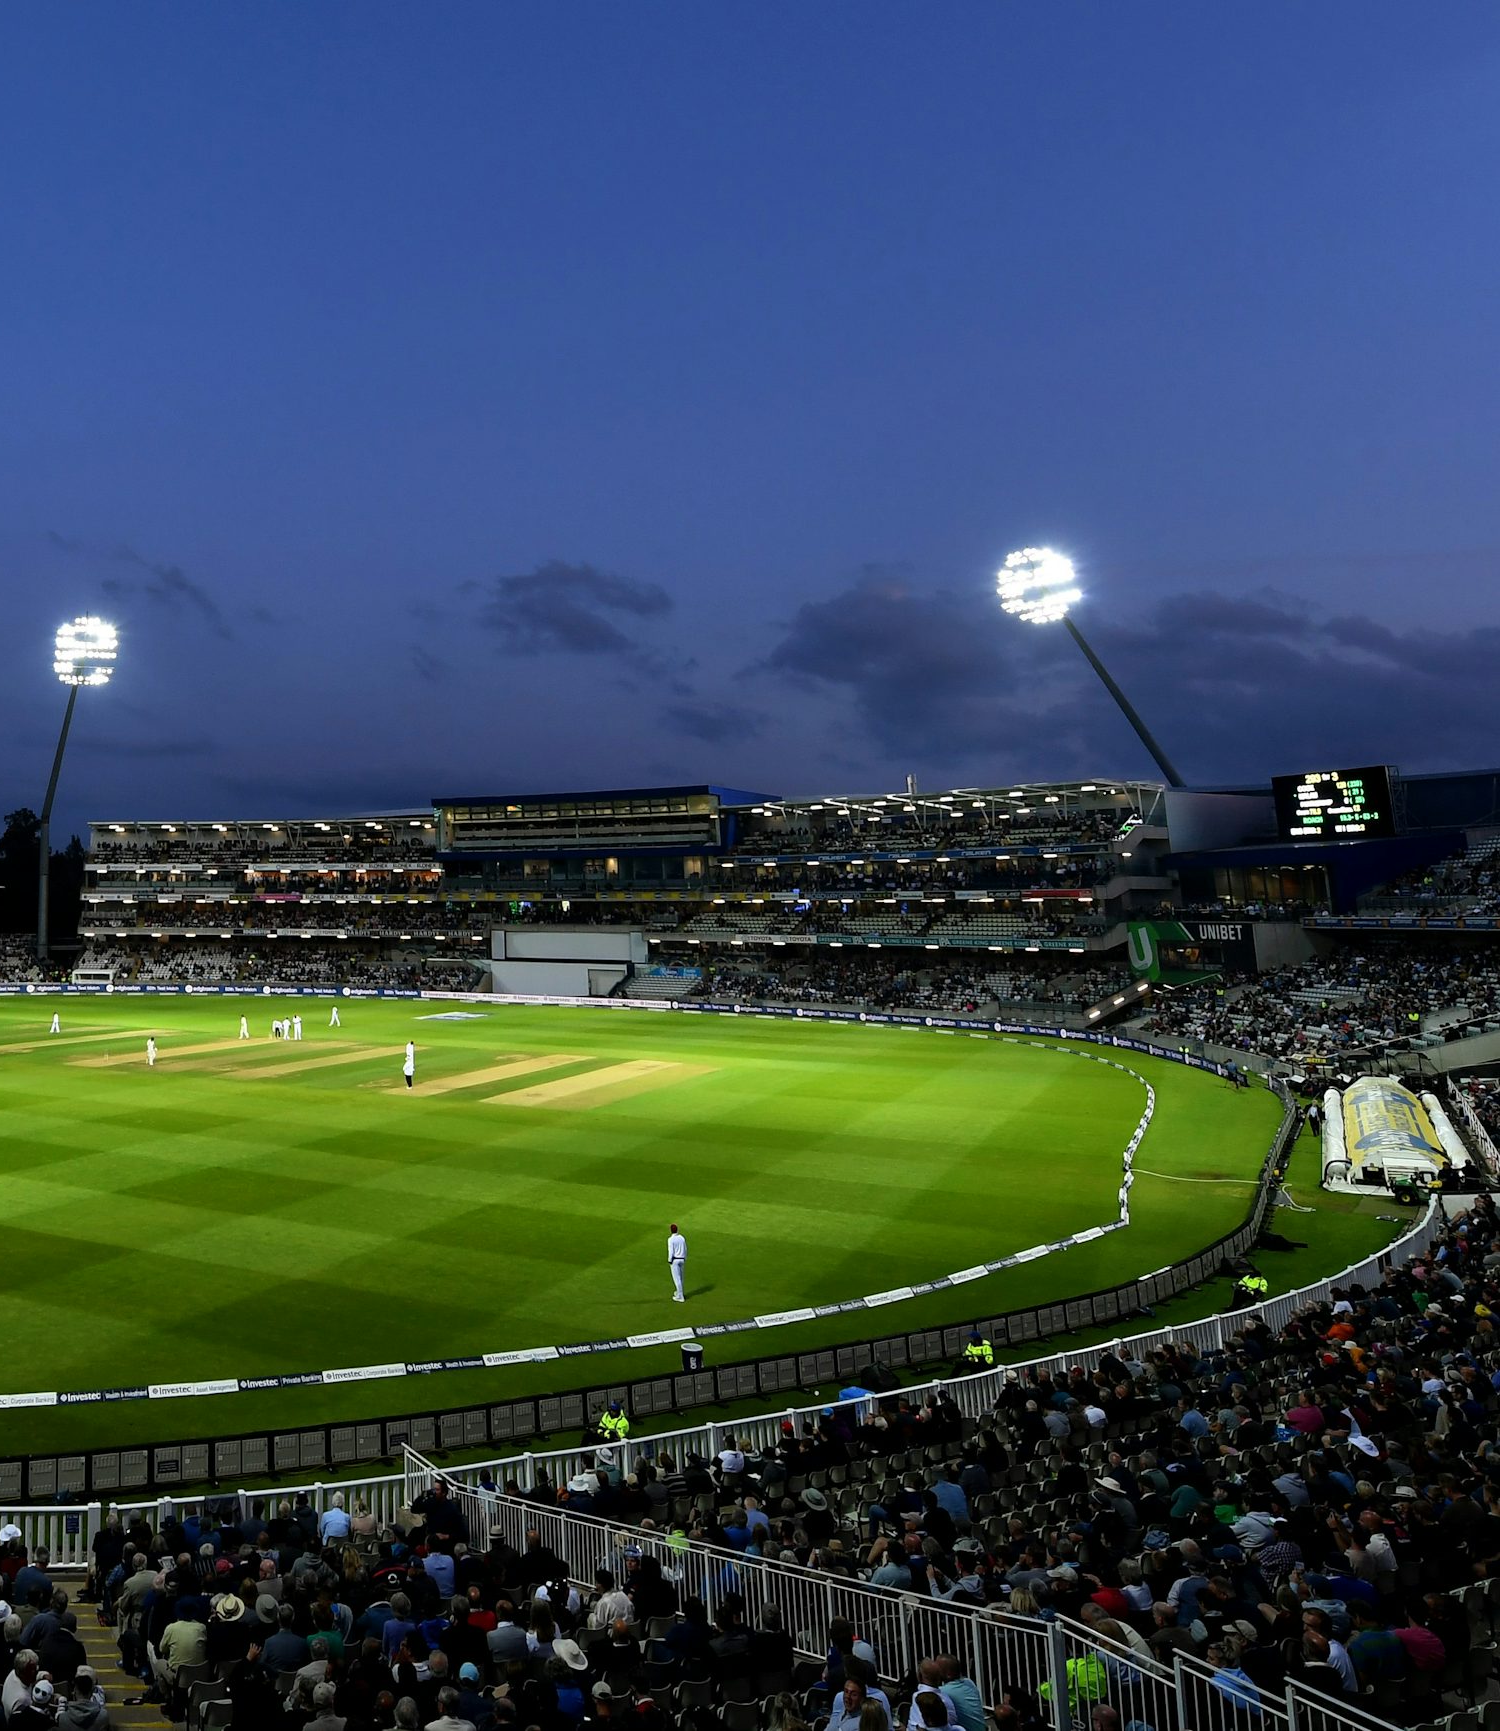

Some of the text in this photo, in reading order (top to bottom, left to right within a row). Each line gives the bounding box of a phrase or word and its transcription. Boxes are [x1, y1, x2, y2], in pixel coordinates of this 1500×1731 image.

[1199, 924, 1242, 941] UNIBET
[635, 1333, 660, 1343] Investec
[564, 1345, 592, 1355] Investec
[492, 1353, 520, 1363] Investec
[412, 1361, 443, 1372] Investec
[332, 1367, 405, 1380] Investec Corporate Banking
[247, 1373, 322, 1389] Investec Private Banking
[67, 1390, 101, 1402] Investec
[159, 1385, 191, 1396] Investec
